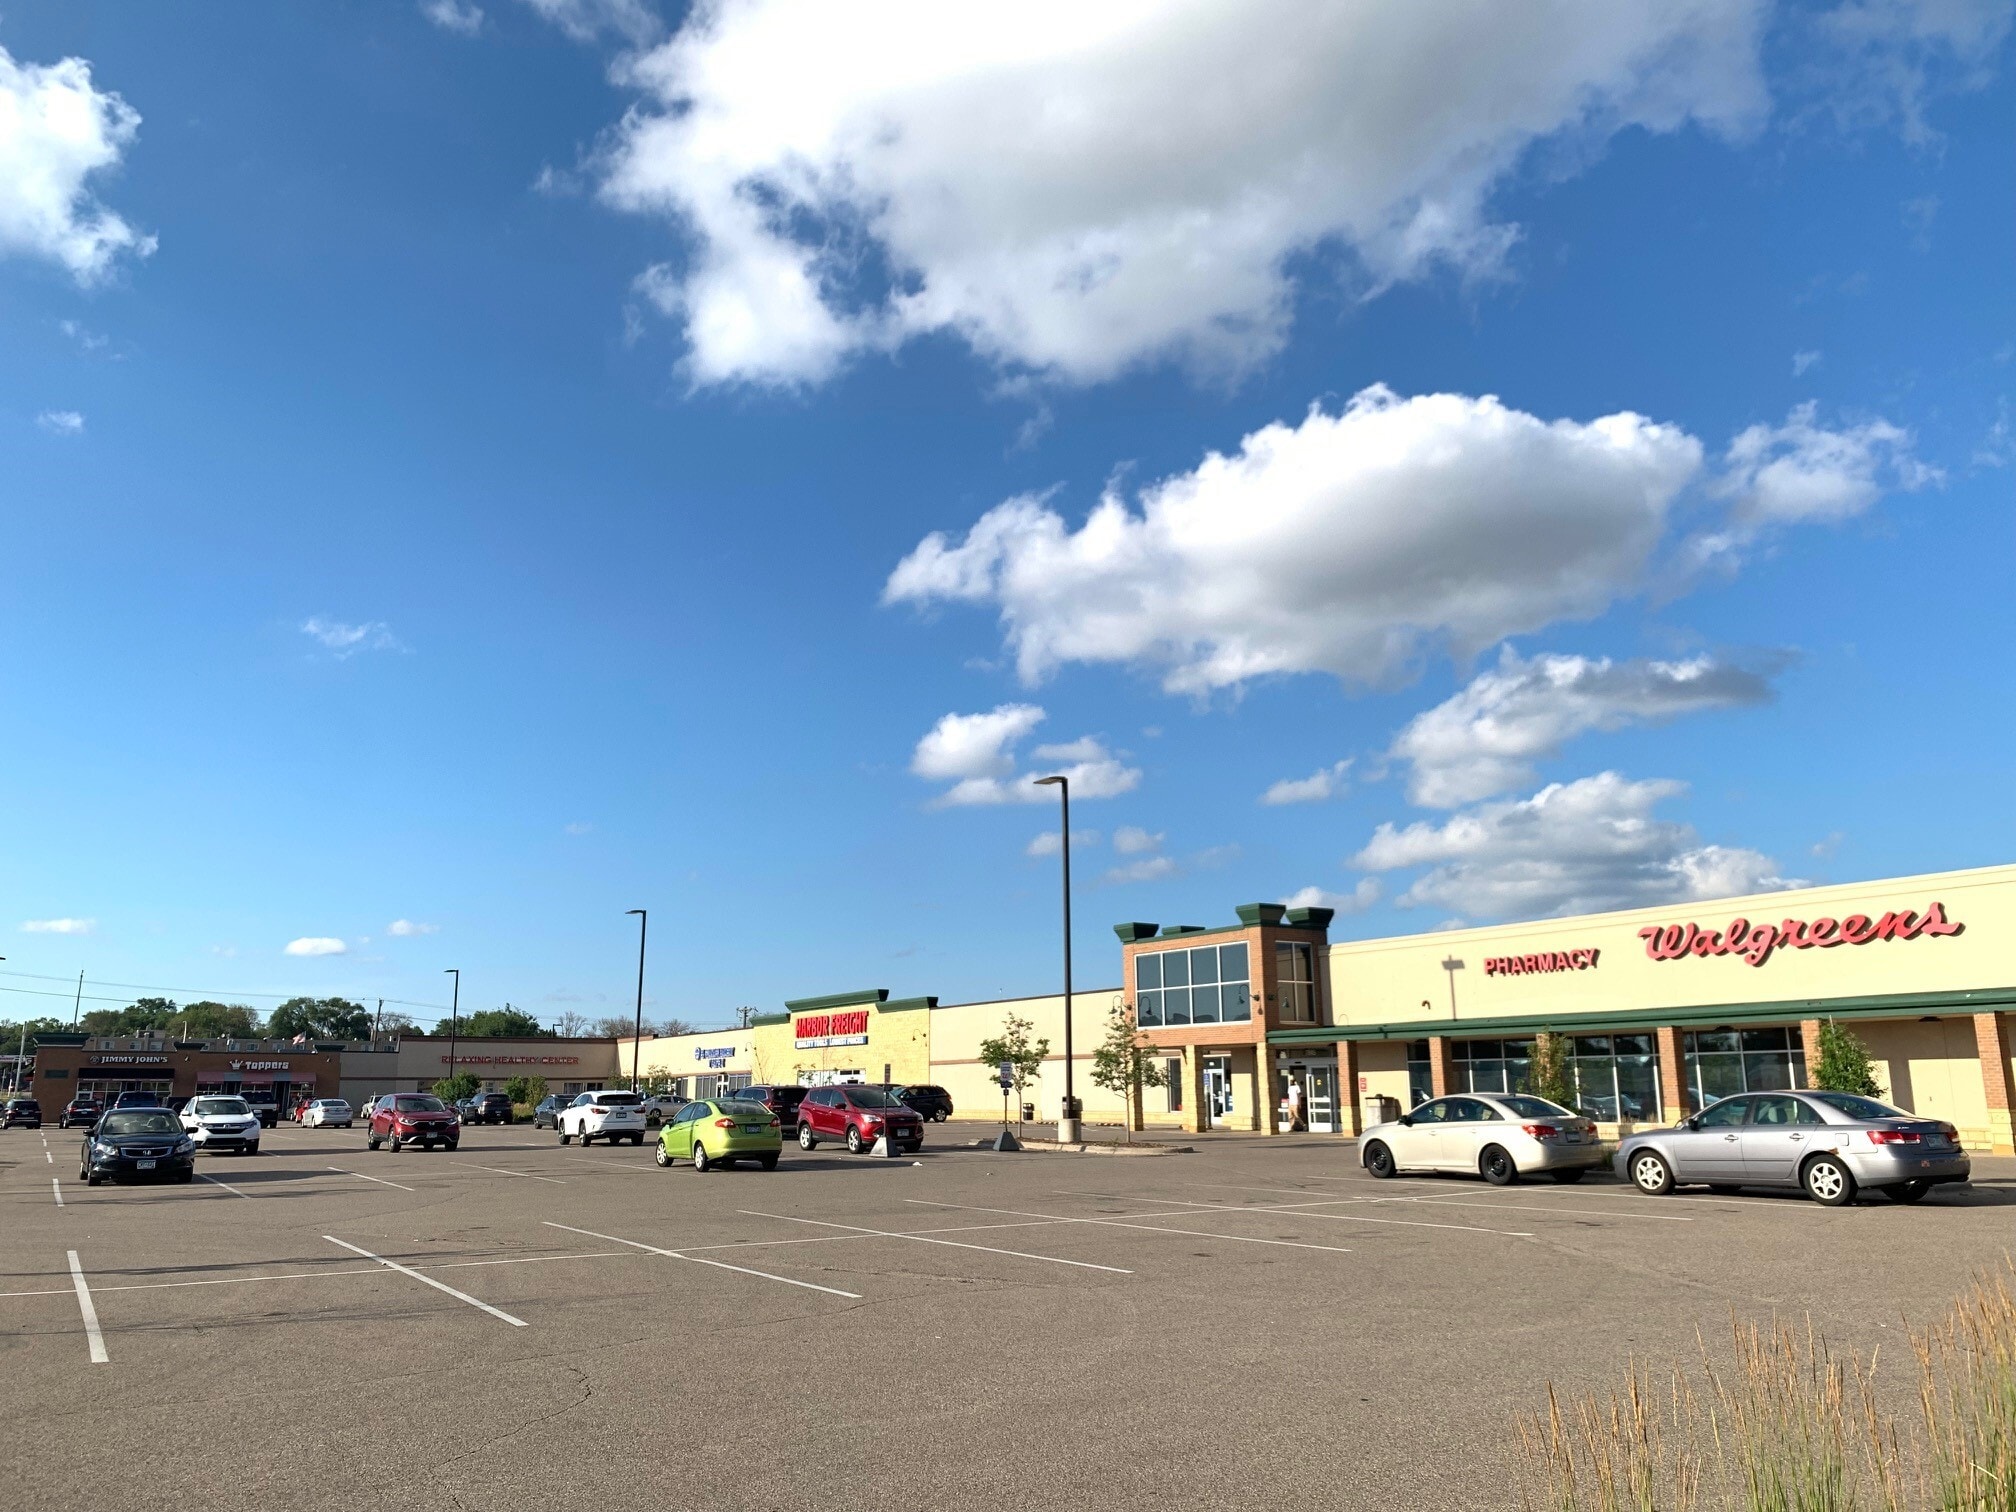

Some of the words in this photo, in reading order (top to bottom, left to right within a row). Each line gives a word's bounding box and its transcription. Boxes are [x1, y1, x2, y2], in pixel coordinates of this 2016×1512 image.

[1638, 901, 1964, 967] Walgreens
[1484, 948, 1599, 976] PHARMACY
[796, 1016, 830, 1038] HARBOR
[831, 1011, 869, 1035] FREIGHT
[441, 1055, 491, 1064] RELAXING
[494, 1056, 538, 1064] HEALTHY
[541, 1056, 579, 1064] CENTER
